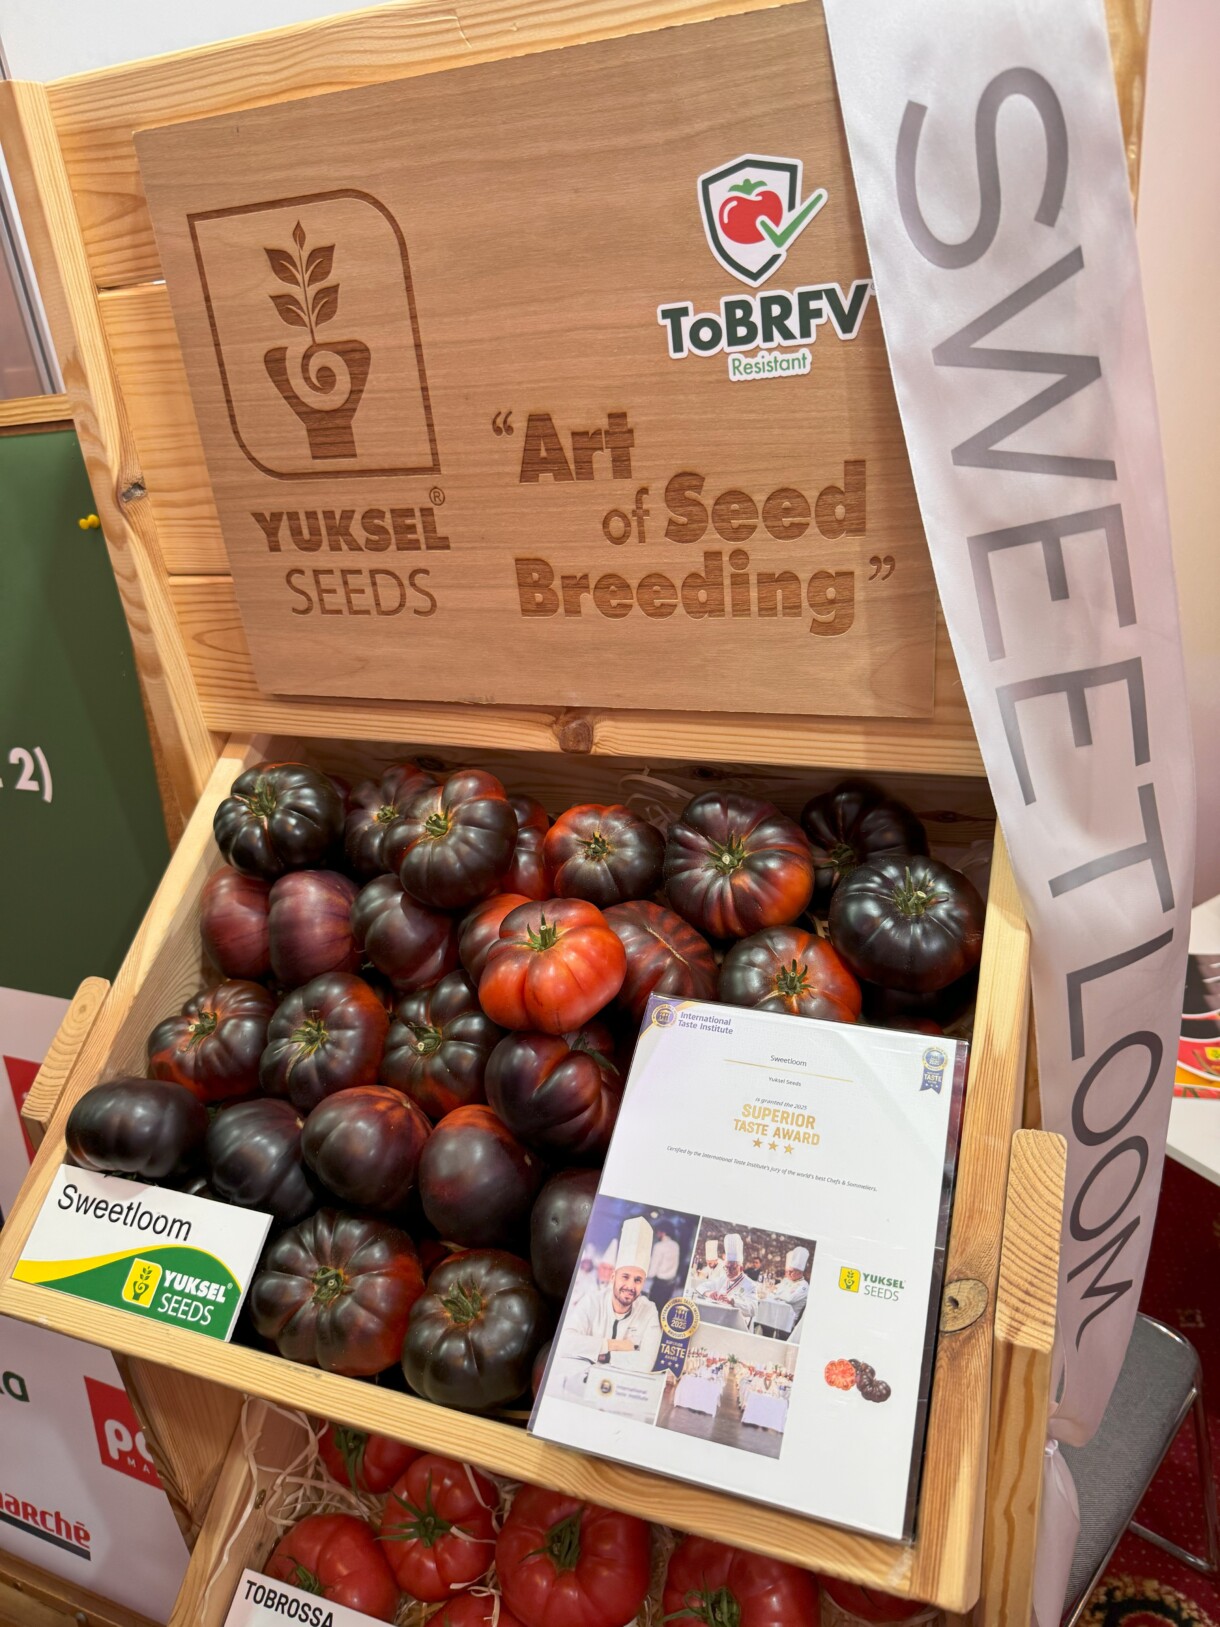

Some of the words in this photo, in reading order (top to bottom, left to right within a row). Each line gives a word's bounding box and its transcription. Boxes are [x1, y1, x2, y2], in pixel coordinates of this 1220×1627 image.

[661, 283, 869, 354] ToBRFV
[732, 352, 808, 376] Resistant
[602, 487, 650, 546] of
[664, 460, 867, 544] Seed
[285, 568, 438, 618] SEEDS
[895, 66, 1176, 1353] SWEETLOOM
[678, 1019, 698, 1030] Taste
[699, 1022, 733, 1035] Institute
[680, 1011, 732, 1026] International
[770, 1055, 807, 1067] Sweetloom
[768, 1076, 786, 1085] Yuksel
[786, 1079, 802, 1087] Seeds
[741, 1103, 816, 1130] SUPERIOR
[761, 1098, 783, 1106] granted
[784, 1101, 794, 1109] the
[794, 1103, 808, 1111] 2025
[733, 1118, 769, 1136] TASTE
[773, 1126, 821, 1146] AWARD
[667, 1145, 687, 1154] Certified
[702, 1152, 733, 1163] International
[733, 1158, 746, 1166] Taste
[769, 1166, 781, 1174] jury
[826, 1177, 841, 1185] Chefs
[57, 1184, 192, 1241] Sweetloom
[862, 1272, 905, 1289] YUKSEL
[863, 1284, 900, 1302] SEEDS
[157, 1293, 215, 1325] SEEDS
[670, 1320, 687, 1330] 2025
[661, 1343, 686, 1358] TASTE
[245, 1579, 334, 1627] TOBROSSA
